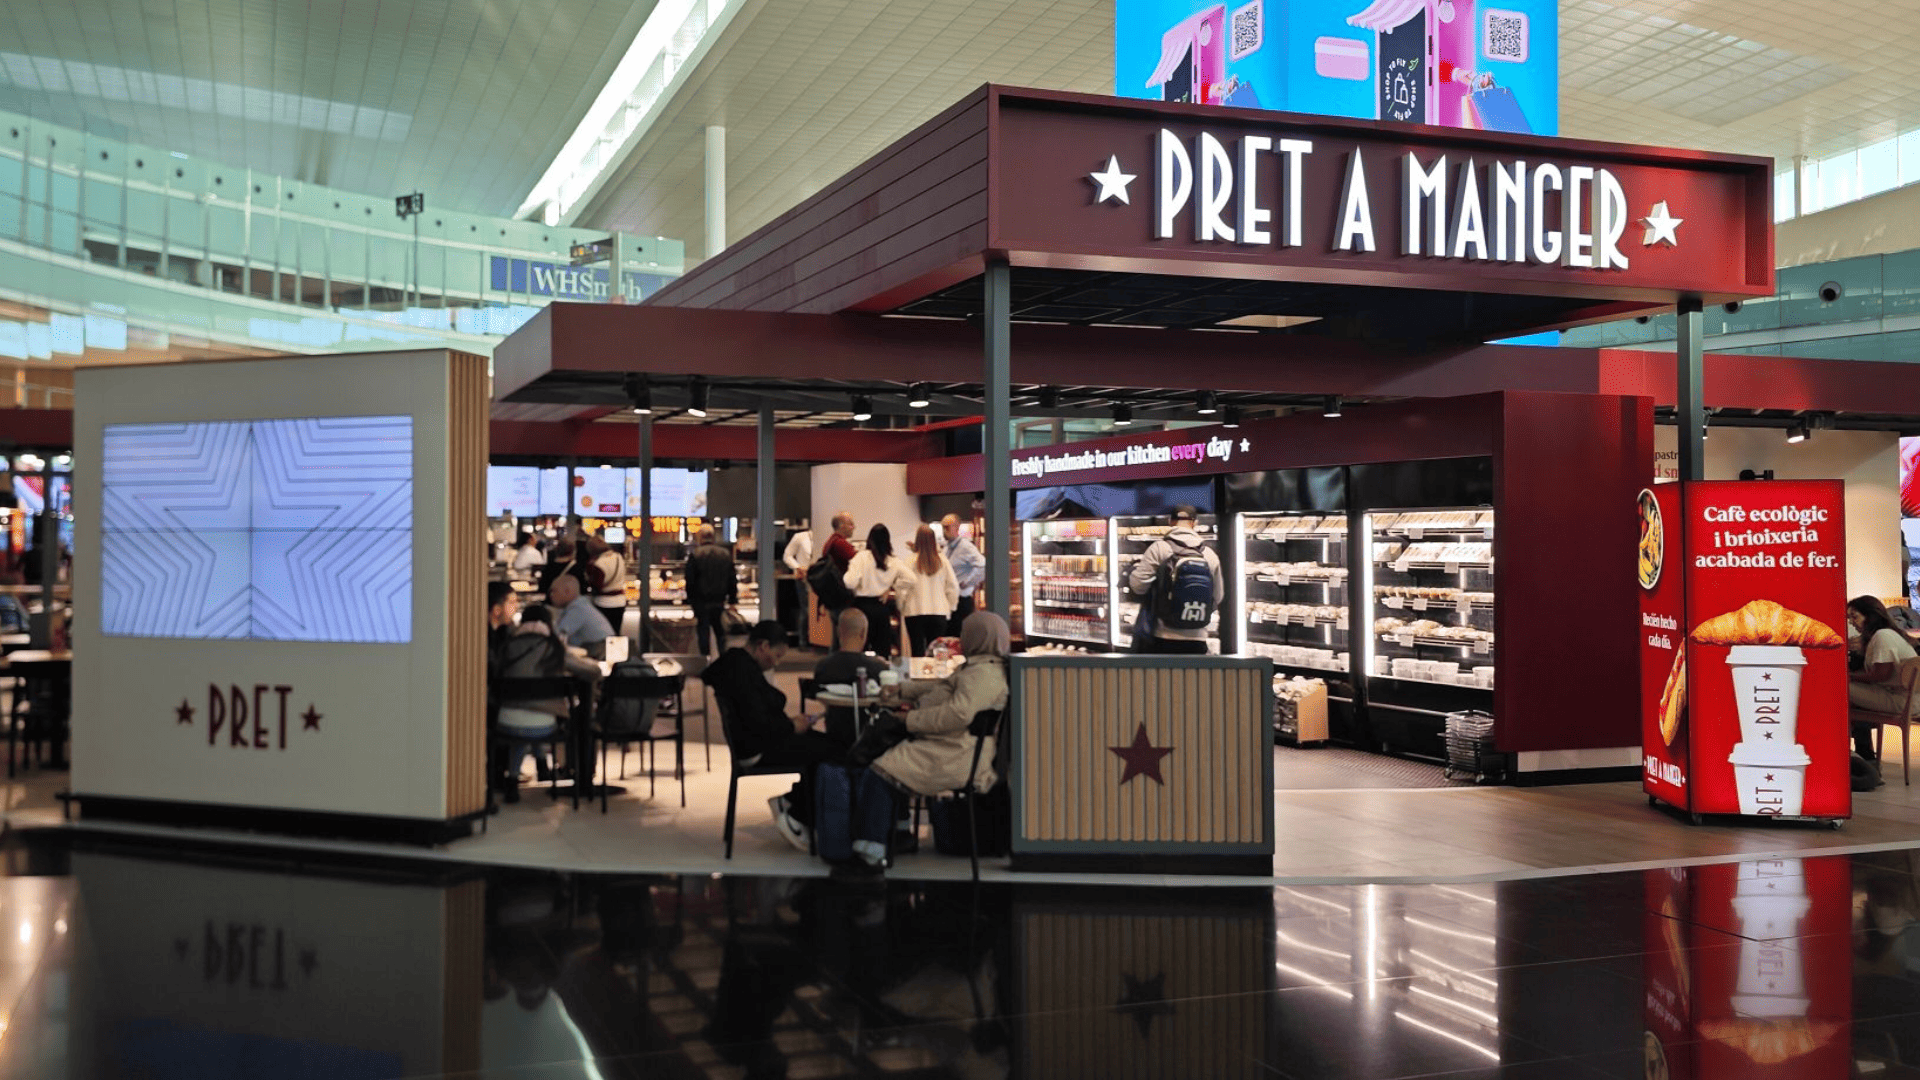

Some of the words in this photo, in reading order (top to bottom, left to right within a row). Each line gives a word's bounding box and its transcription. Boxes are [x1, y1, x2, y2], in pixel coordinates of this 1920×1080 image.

[1396, 58, 1406, 67] FLY
[1156, 128, 1313, 247] PRET
[1333, 145, 1376, 252] A
[1403, 150, 1629, 270] MANGER
[1011, 456, 1044, 478] Freshly
[1044, 450, 1096, 473] handmade
[1095, 449, 1107, 467] in
[1107, 448, 1128, 467] our
[1127, 443, 1171, 465] kitchen
[1171, 442, 1205, 463] every
[1206, 436, 1233, 461] day
[1749, 505, 1828, 525] ecològic
[1714, 532, 1721, 548] i
[1724, 526, 1819, 547] brioixeria
[1696, 552, 1775, 568] acabada
[1779, 552, 1803, 568] de
[1807, 551, 1839, 568] fer.
[207, 683, 293, 750] PRET
[1753, 685, 1781, 725] PRET
